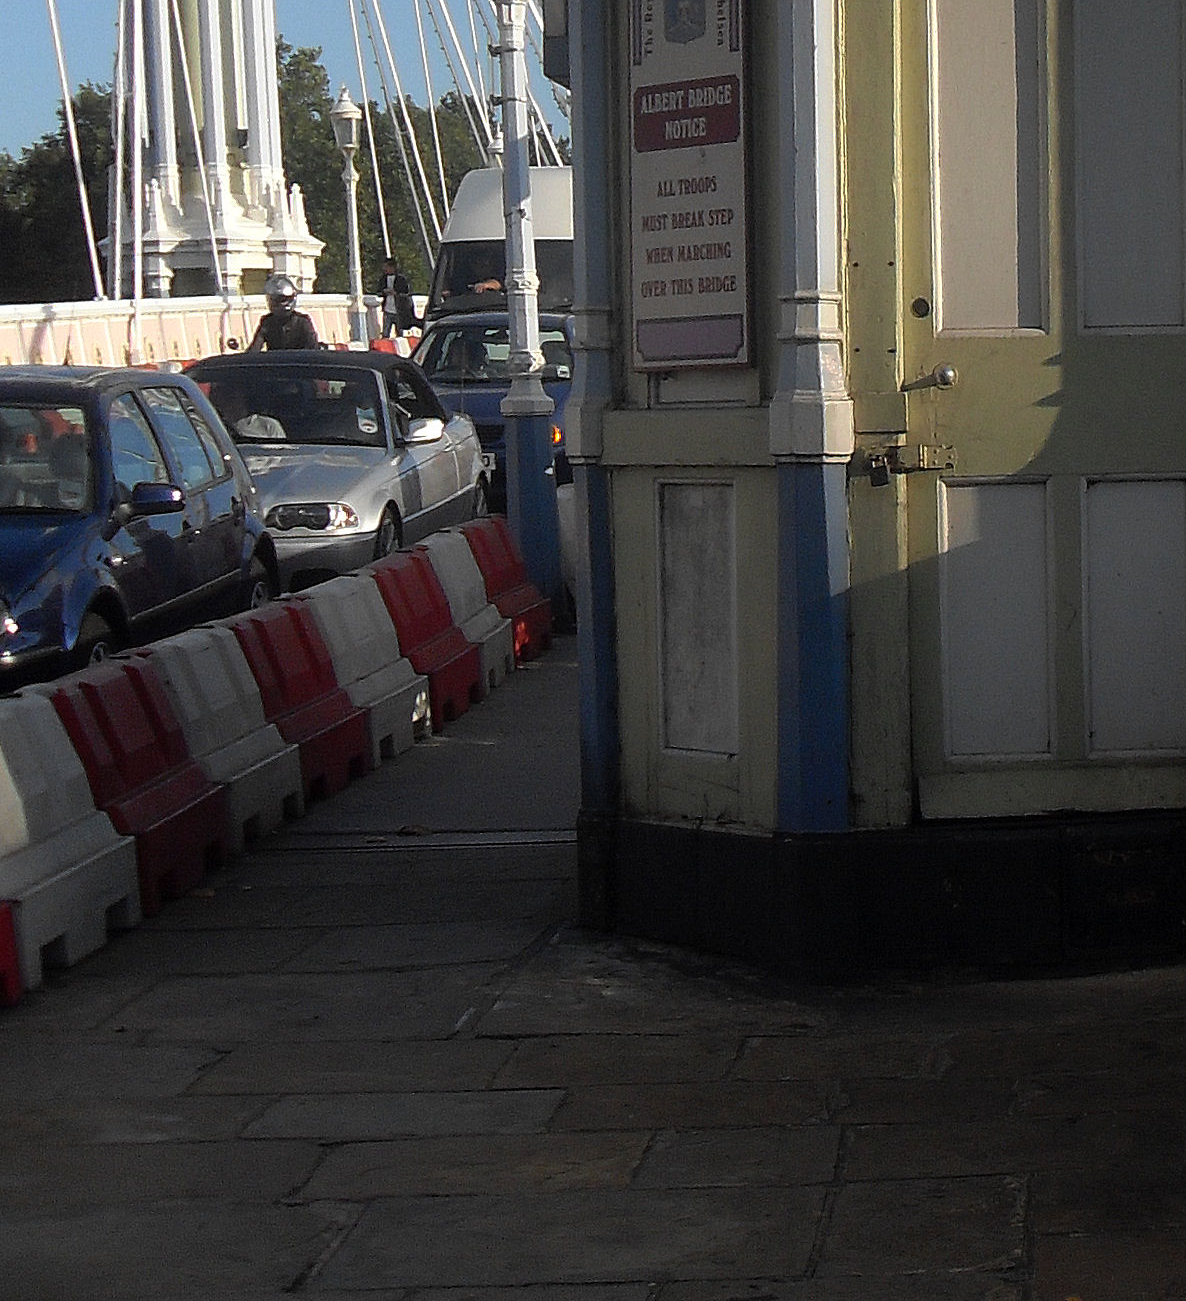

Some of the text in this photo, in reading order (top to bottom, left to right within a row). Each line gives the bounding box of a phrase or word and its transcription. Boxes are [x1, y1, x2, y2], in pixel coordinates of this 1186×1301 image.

[644, 29, 653, 55] The
[640, 84, 733, 114] ALBERT BRIDGE
[665, 117, 707, 140] NOTICE
[657, 175, 717, 198] ALL TROOPS
[641, 208, 734, 233] MUST BREAK STEP
[646, 241, 731, 264] WHEN MARCHING
[641, 275, 737, 299] OVER THIS BRIDGE
